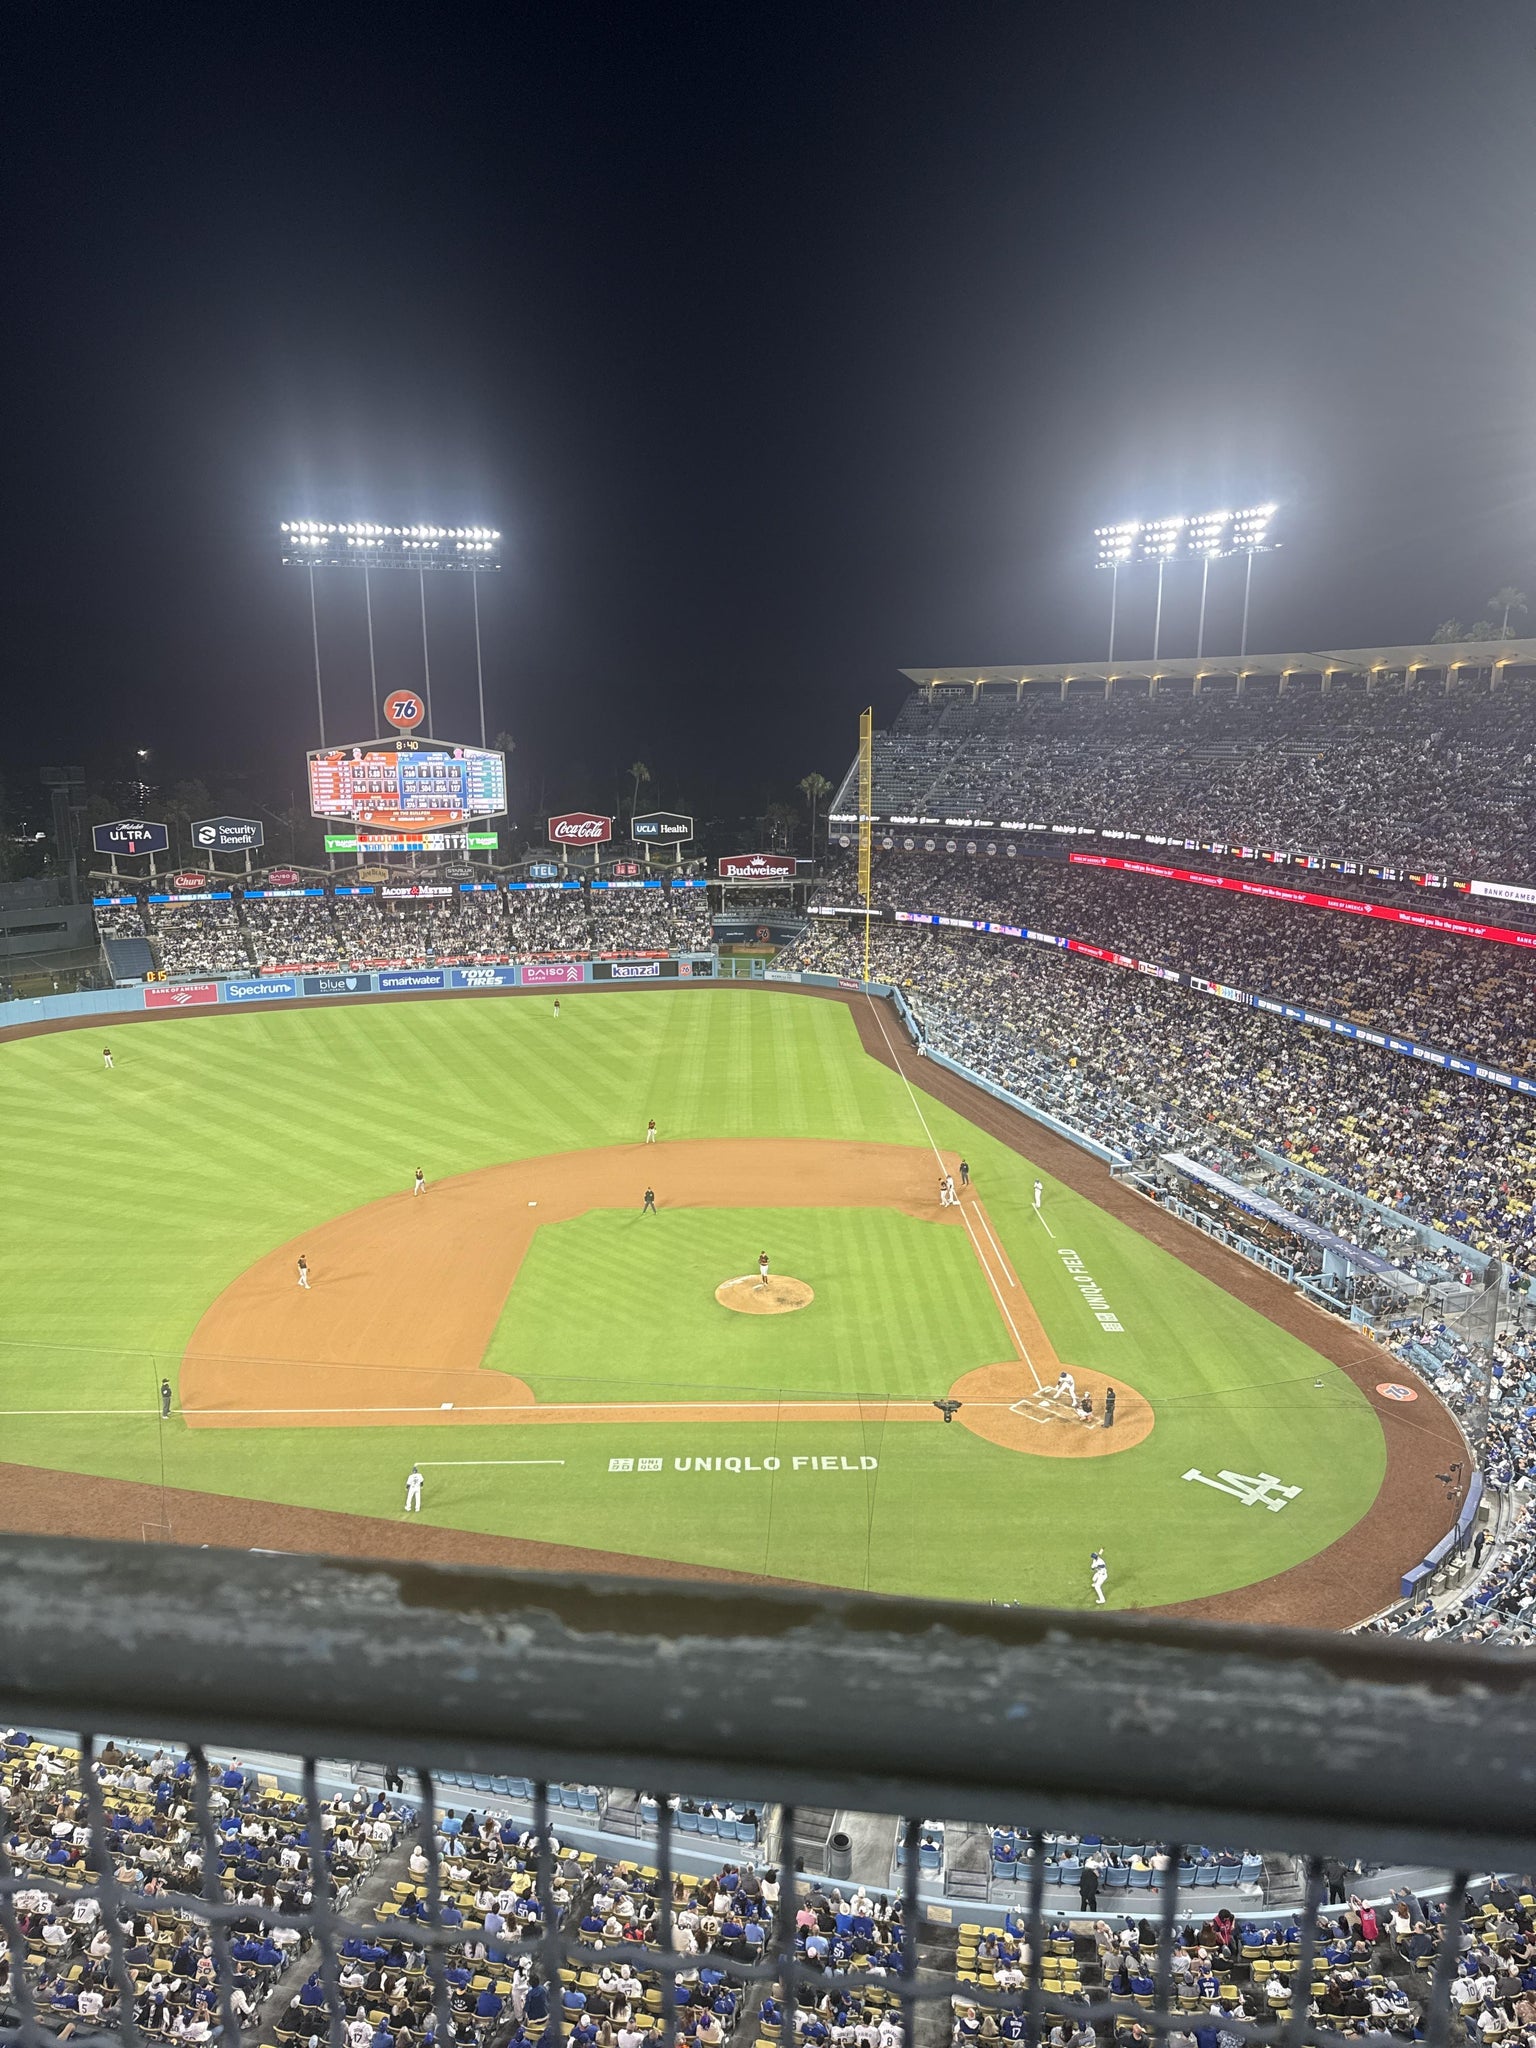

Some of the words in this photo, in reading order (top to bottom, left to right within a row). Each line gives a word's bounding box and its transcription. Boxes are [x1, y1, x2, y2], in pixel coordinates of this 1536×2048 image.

[392, 699, 418, 719] 76
[396, 741, 419, 750] 8:40
[218, 826, 256, 836] Security
[555, 820, 605, 838] Coca-Cola
[660, 824, 688, 834] Health
[110, 830, 152, 841] ULTRA
[220, 834, 252, 844] Benefit
[533, 866, 554, 876] TEL
[727, 864, 789, 876] Budweiser
[175, 876, 204, 886] Churu
[1484, 888, 1502, 897] BANK
[1504, 890, 1514, 898] OF
[1425, 918, 1434, 926] you
[1452, 924, 1468, 933] power
[146, 970, 167, 982] 0:15
[460, 970, 494, 978] TOYO
[528, 968, 564, 976] DAISO
[320, 978, 345, 990] blue
[382, 975, 440, 986] smartwater
[466, 976, 502, 986] TIRES
[230, 983, 287, 998] Spectrum
[1057, 1249, 1089, 1274] FIELD
[1073, 1276, 1110, 1310] UNIQLO
[1386, 1384, 1410, 1400] 76
[674, 1456, 781, 1473] UNIQLO
[792, 1456, 878, 1471] FIELD
[1180, 1468, 1304, 1513] LA
[500, 1900, 509, 1910] 17
[77, 1908, 86, 1918] 17
[518, 1908, 528, 1917] 50
[703, 1922, 716, 1931] 42
[834, 1948, 844, 1959] 50
[1204, 1988, 1215, 1998] 17
[1466, 1987, 1475, 1996] 10
[1486, 1987, 1492, 1996] 5
[81, 2004, 88, 2014] 5
[1012, 2028, 1021, 2038] 17
[354, 2033, 362, 2044] 17
[887, 2036, 893, 2046] 8
